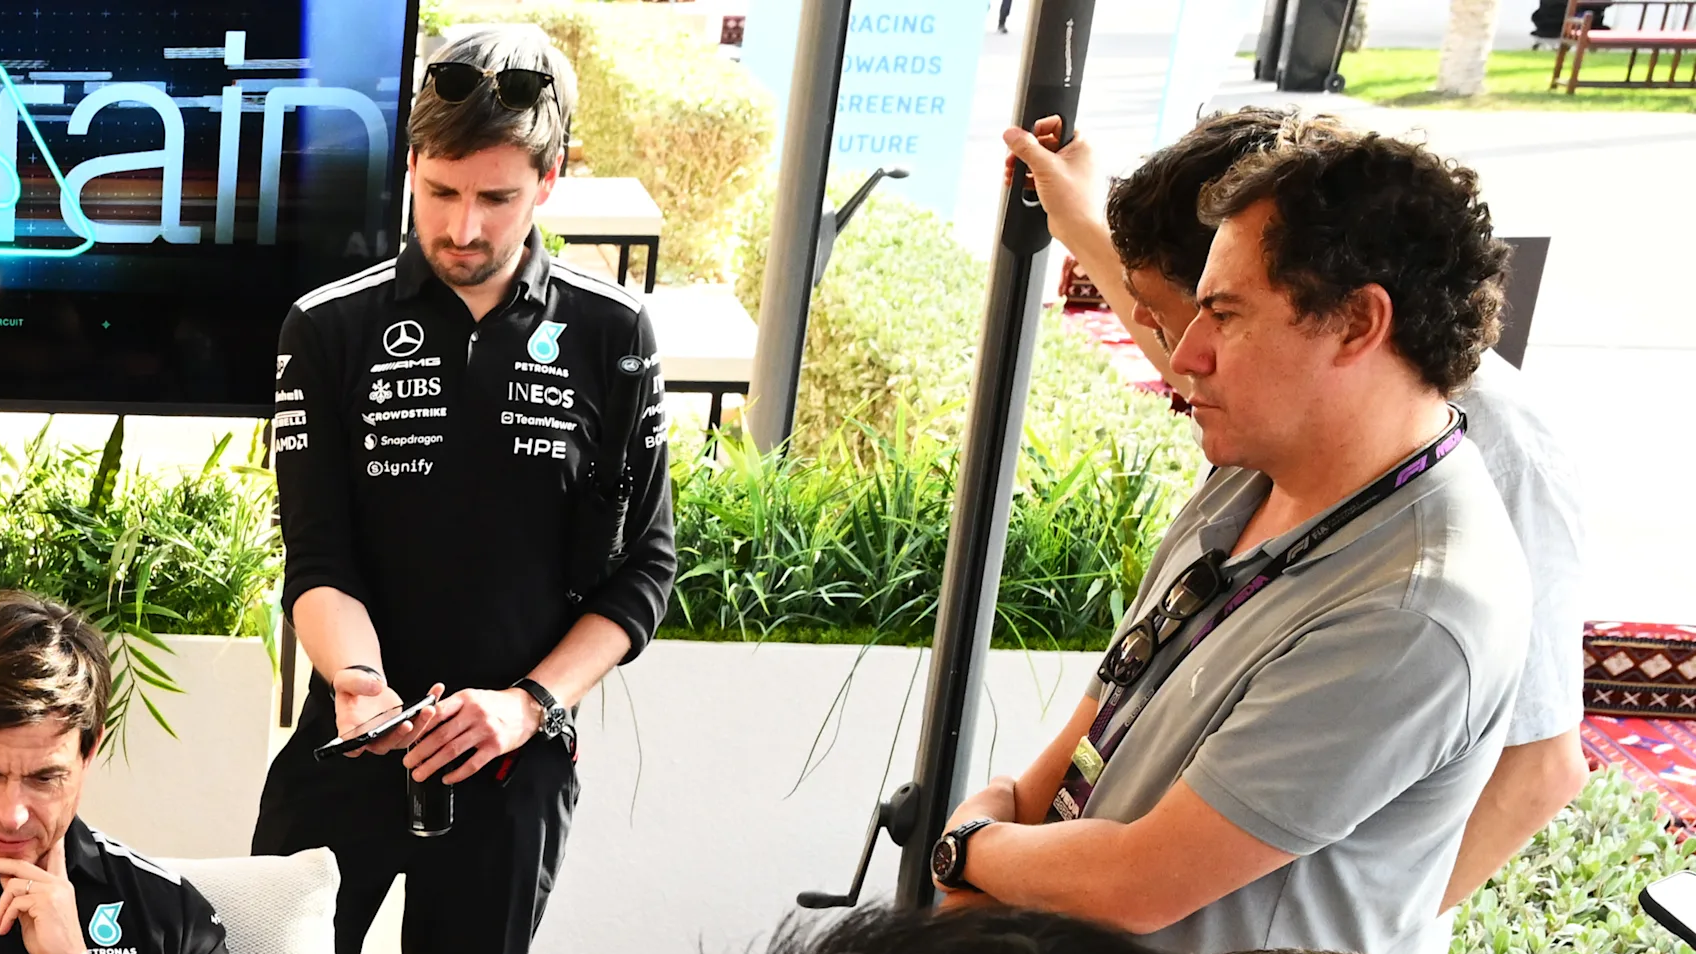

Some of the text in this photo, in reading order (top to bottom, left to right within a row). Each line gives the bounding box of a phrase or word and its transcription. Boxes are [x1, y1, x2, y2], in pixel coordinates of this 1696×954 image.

[844, 55, 942, 74] OWARDS
[838, 134, 918, 153] UTURE
[514, 361, 570, 378] PETRONAS
[396, 377, 442, 399] UBS
[508, 381, 575, 409] INEOS
[367, 407, 448, 422] CROWDSTRIKE
[515, 413, 578, 431] TeamViewer
[276, 435, 296, 453] AMD
[381, 434, 443, 447] Snapdragon
[513, 437, 567, 459] HPE
